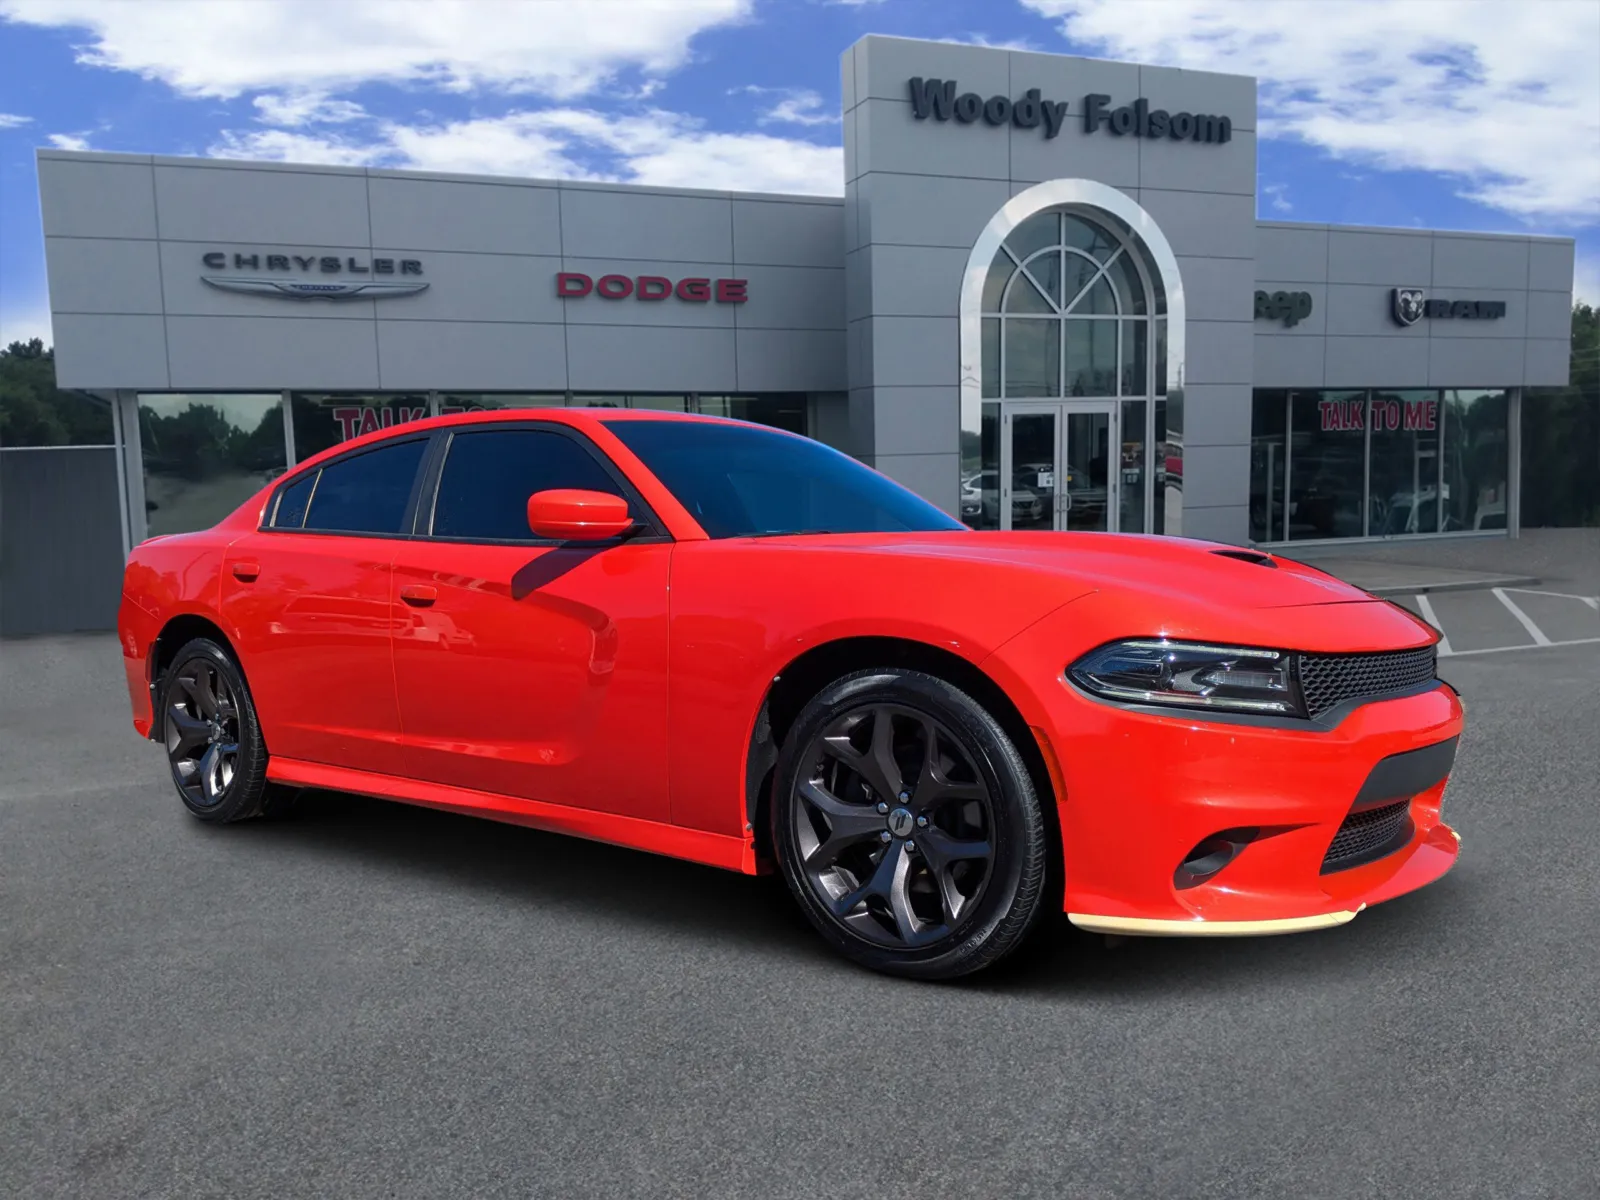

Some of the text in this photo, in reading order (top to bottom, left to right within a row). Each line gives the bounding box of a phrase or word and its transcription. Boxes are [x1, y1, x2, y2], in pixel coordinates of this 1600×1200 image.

[908, 76, 1232, 144] Woody Folsom
[202, 252, 424, 275] CHRYSLER
[557, 272, 748, 302] DODGE
[1254, 290, 1312, 328] eep
[1425, 299, 1506, 319] RAM
[1318, 399, 1438, 431] TALK TO ME
